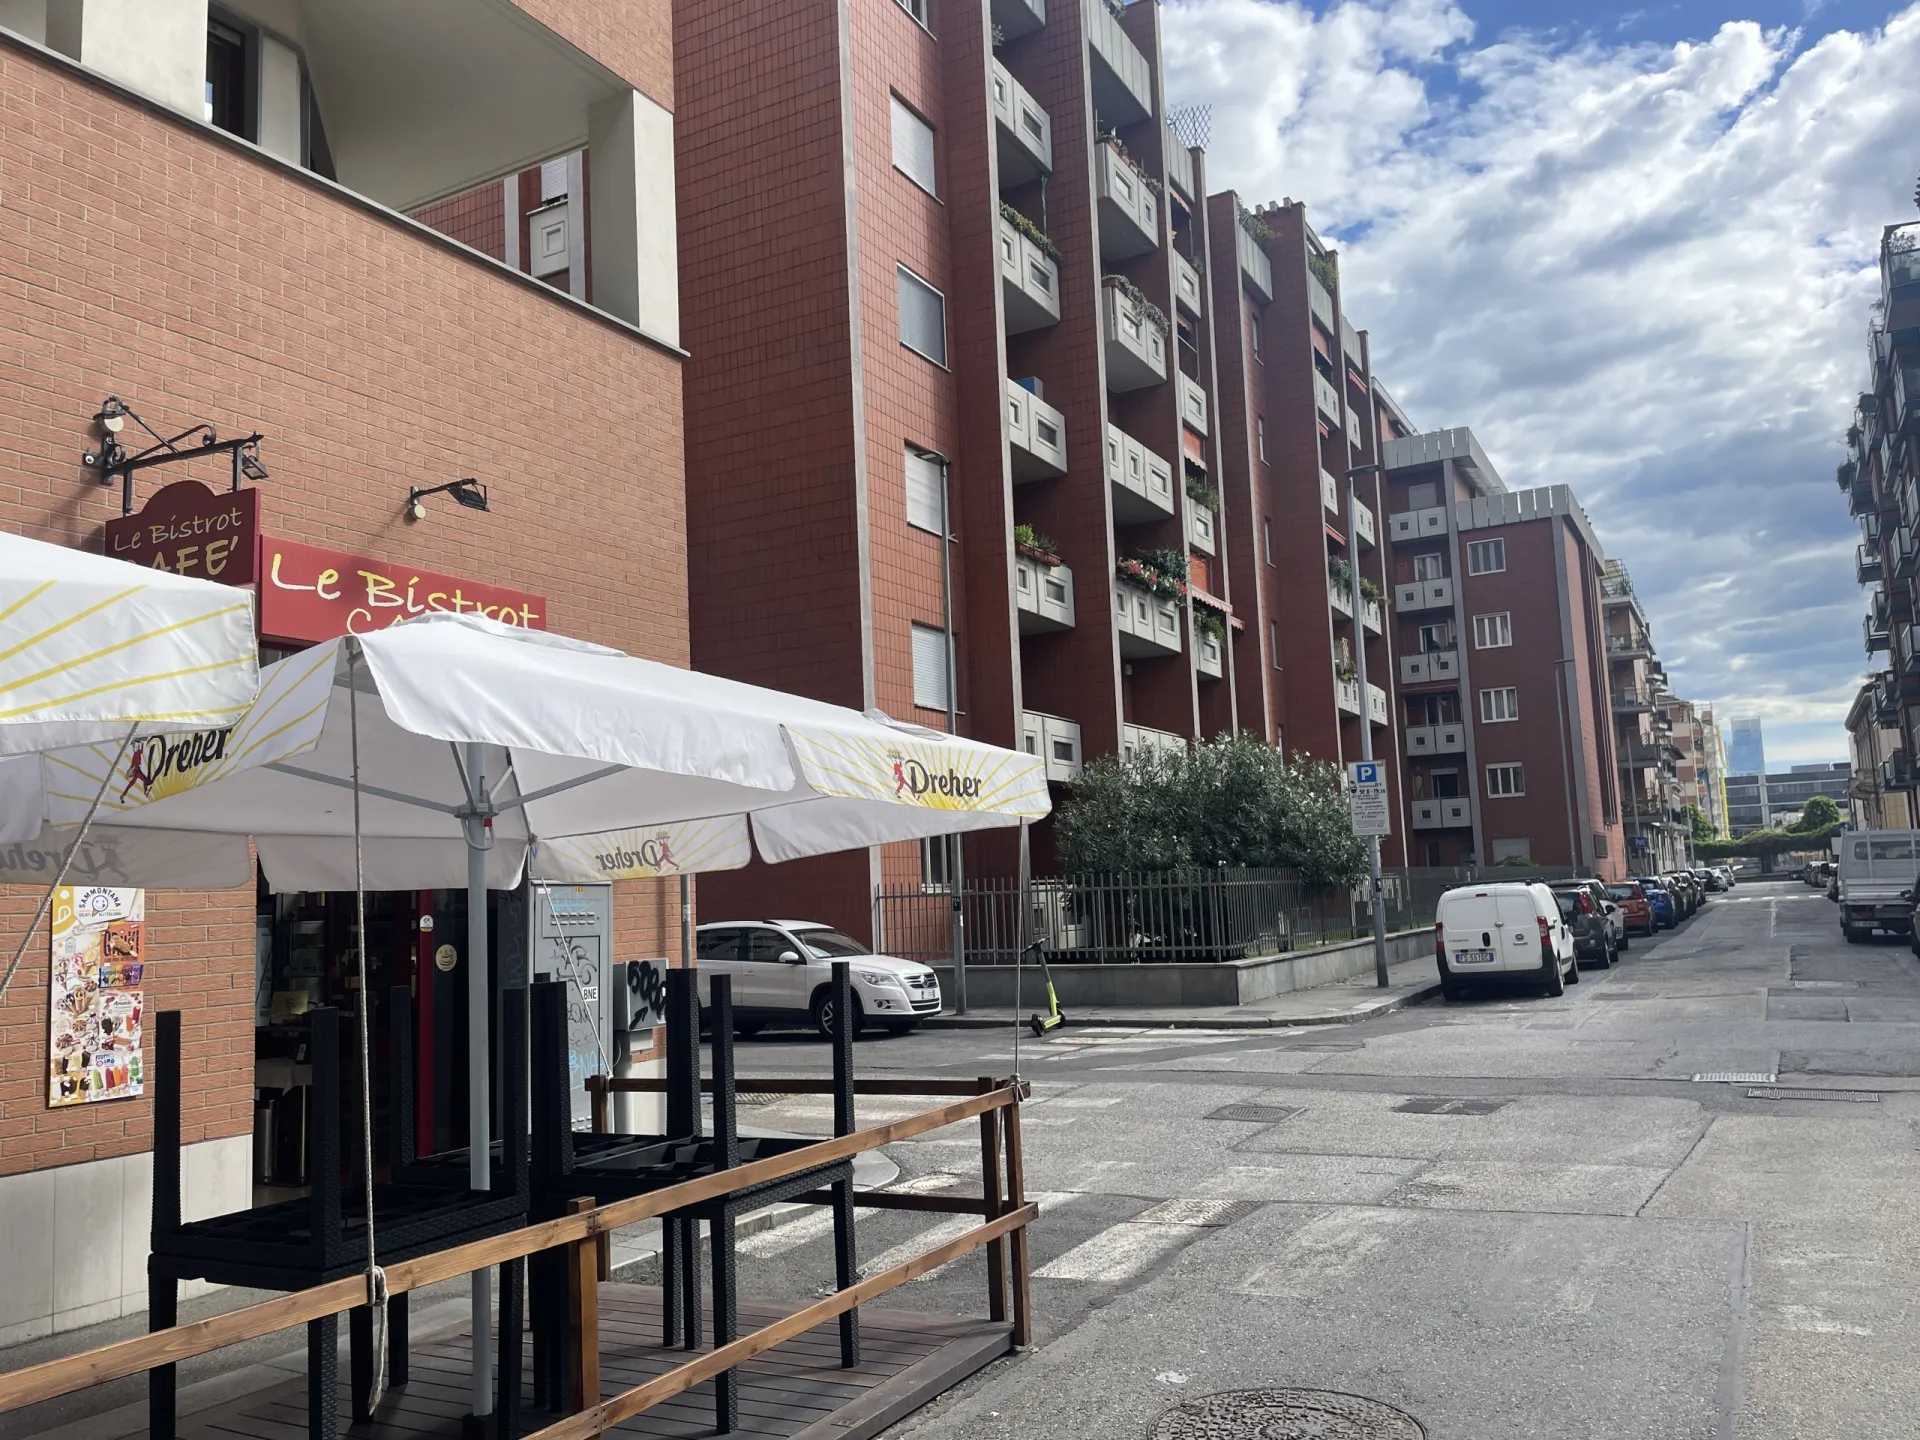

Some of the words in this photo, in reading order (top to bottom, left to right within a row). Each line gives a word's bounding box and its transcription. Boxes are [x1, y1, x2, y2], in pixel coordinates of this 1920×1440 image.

[114, 531, 142, 551] Le
[148, 507, 242, 544] Bistrot
[126, 535, 238, 576] AFE'
[271, 553, 341, 600] Le
[146, 729, 232, 787] Dreher
[1361, 767, 1372, 780] P
[905, 759, 981, 798] Dreher
[79, 887, 122, 909] SAMMONTANA
[583, 988, 597, 1000] BNE
